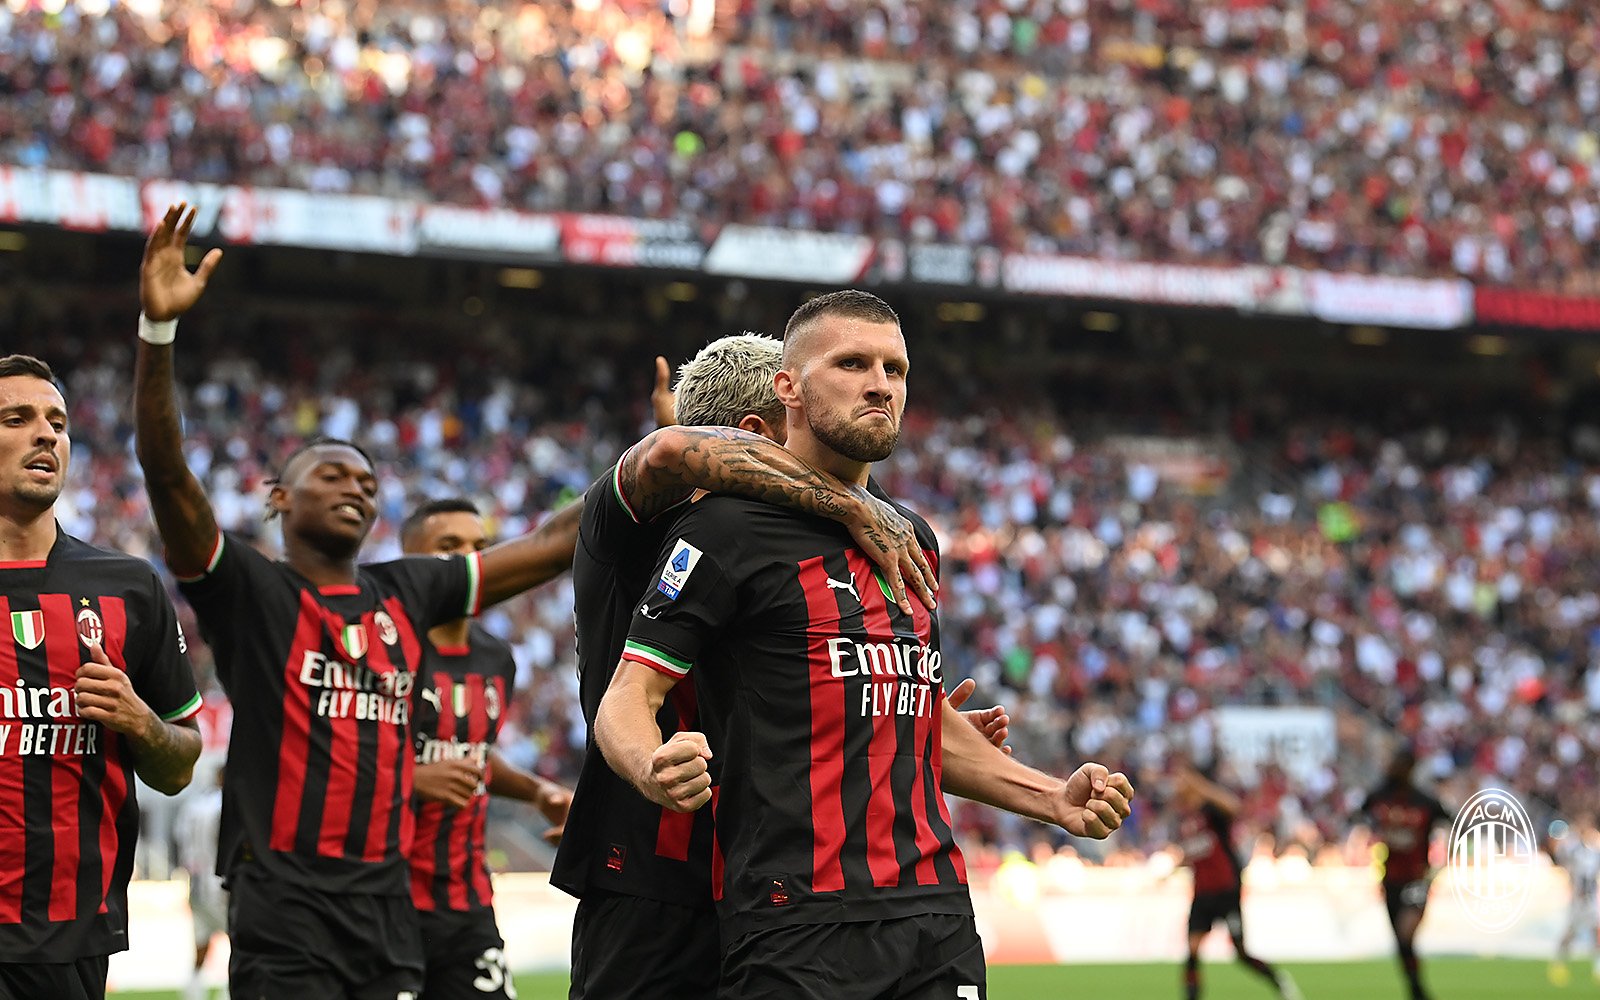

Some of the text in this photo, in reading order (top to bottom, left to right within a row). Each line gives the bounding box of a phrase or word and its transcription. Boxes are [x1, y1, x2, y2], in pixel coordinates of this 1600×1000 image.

[664, 585, 677, 597] TIM
[317, 690, 354, 718] FLY
[861, 683, 892, 716] FLY
[18, 724, 97, 755] BETTER
